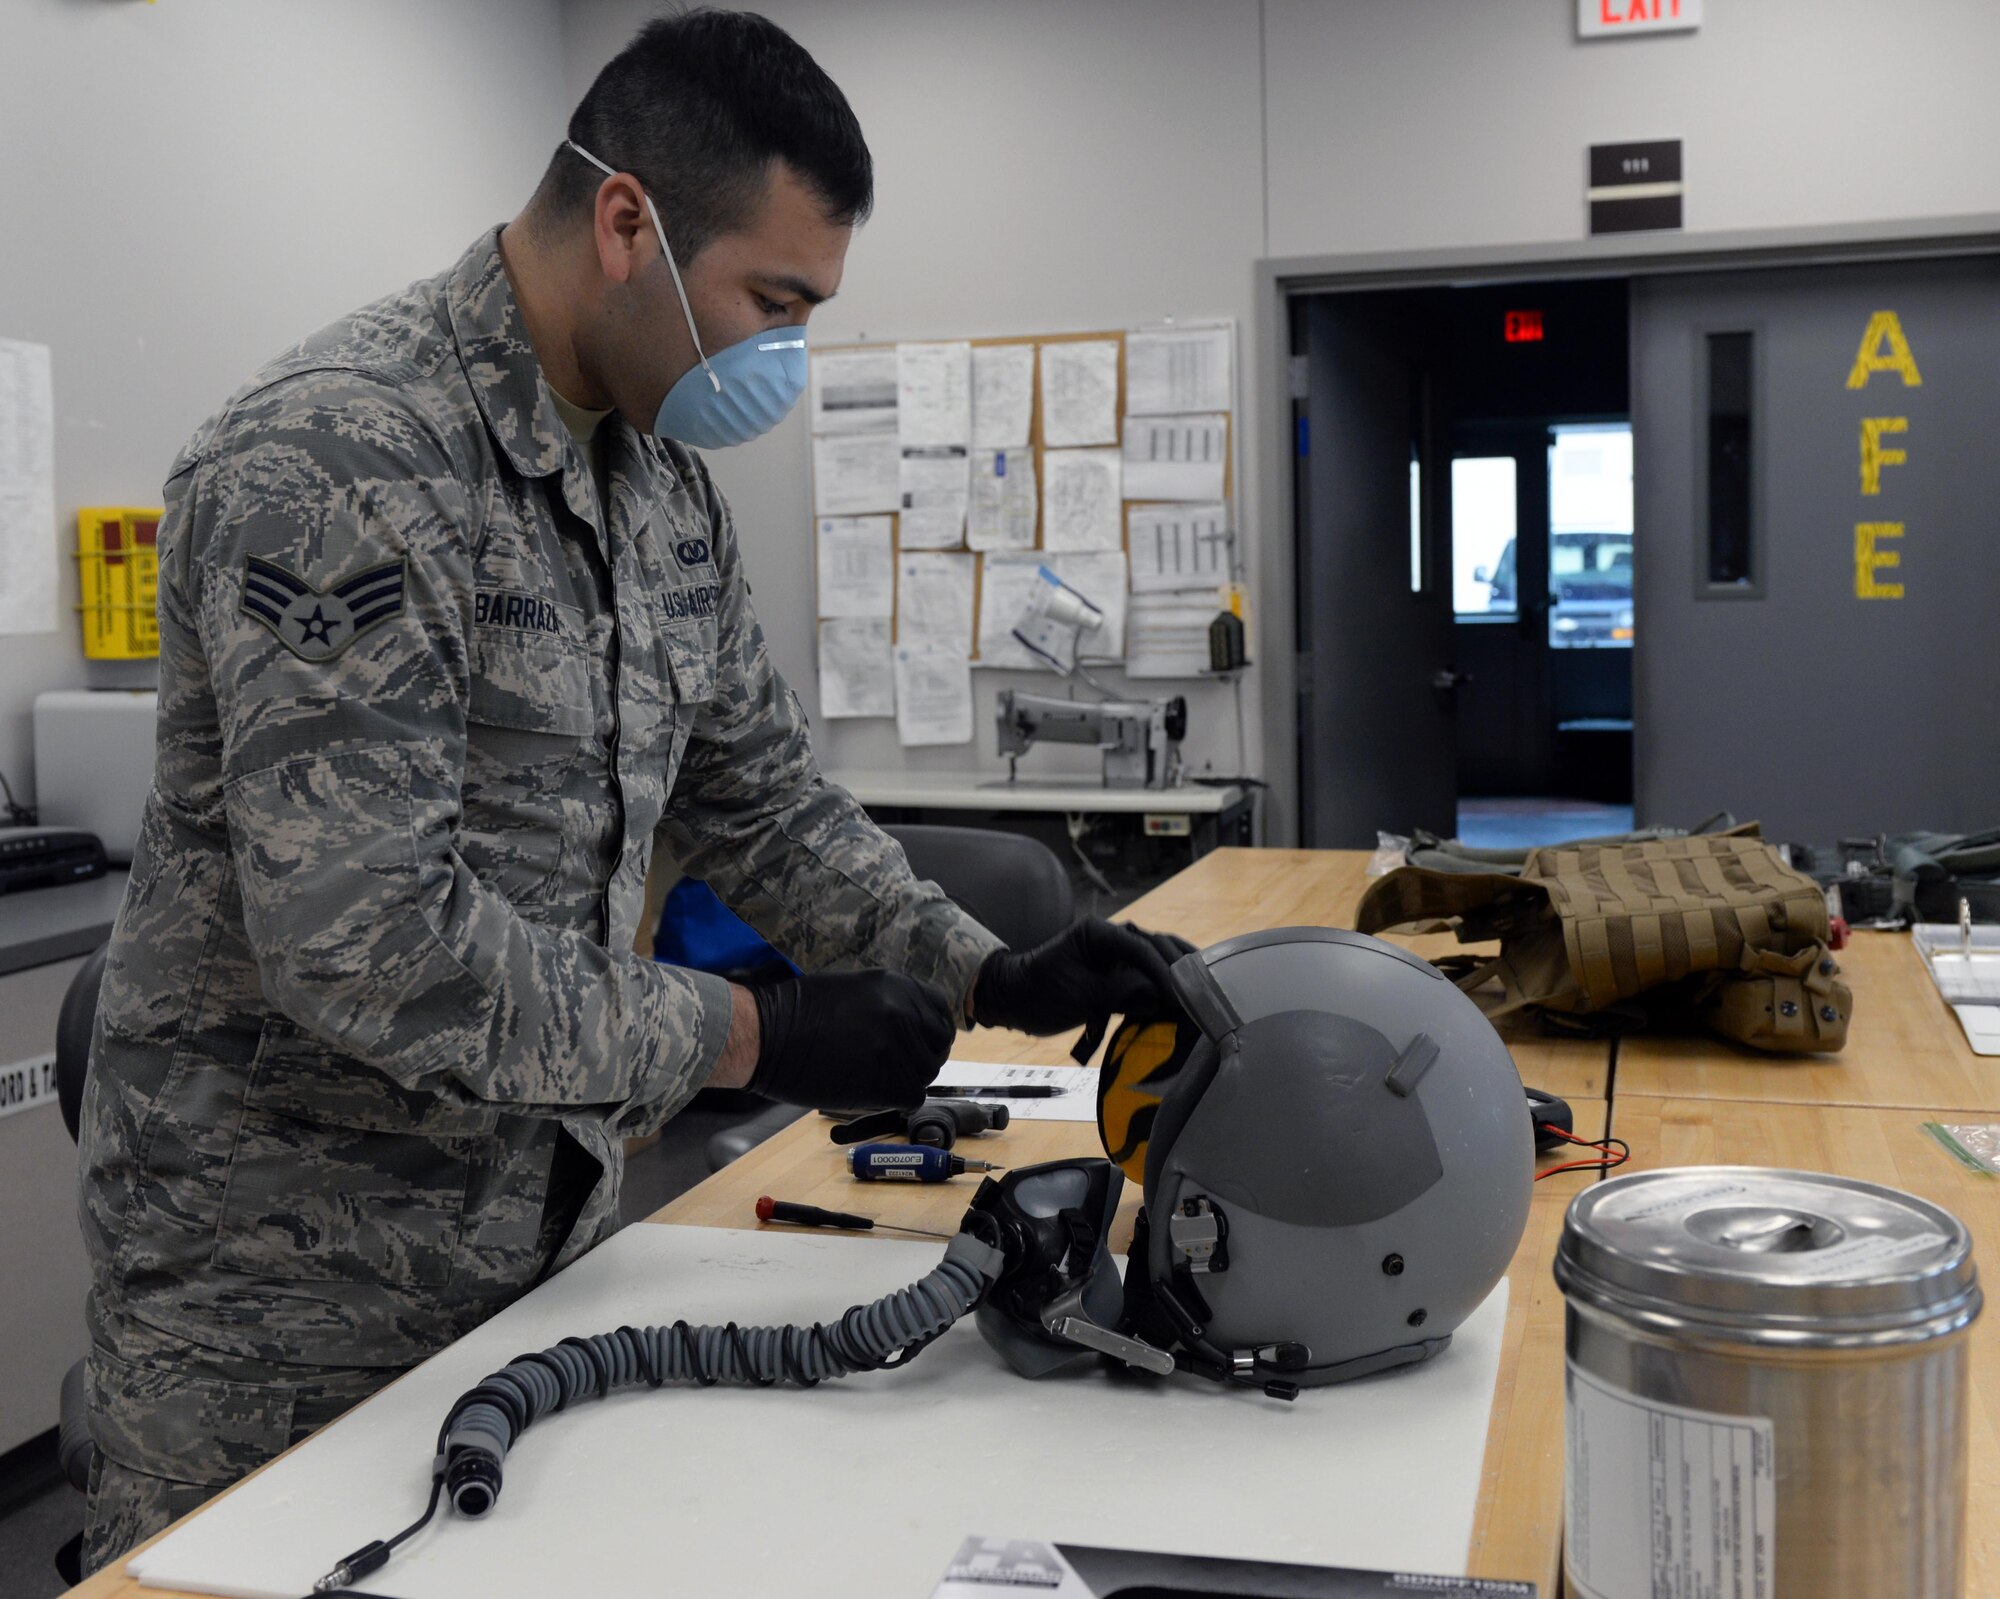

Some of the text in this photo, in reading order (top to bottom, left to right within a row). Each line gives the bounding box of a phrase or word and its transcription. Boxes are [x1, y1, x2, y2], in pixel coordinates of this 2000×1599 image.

[1622, 157, 1649, 174] 111
[1504, 310, 1543, 342] EXIT
[474, 593, 560, 635] BARRAZA
[873, 1155, 922, 1165] EJ0700001
